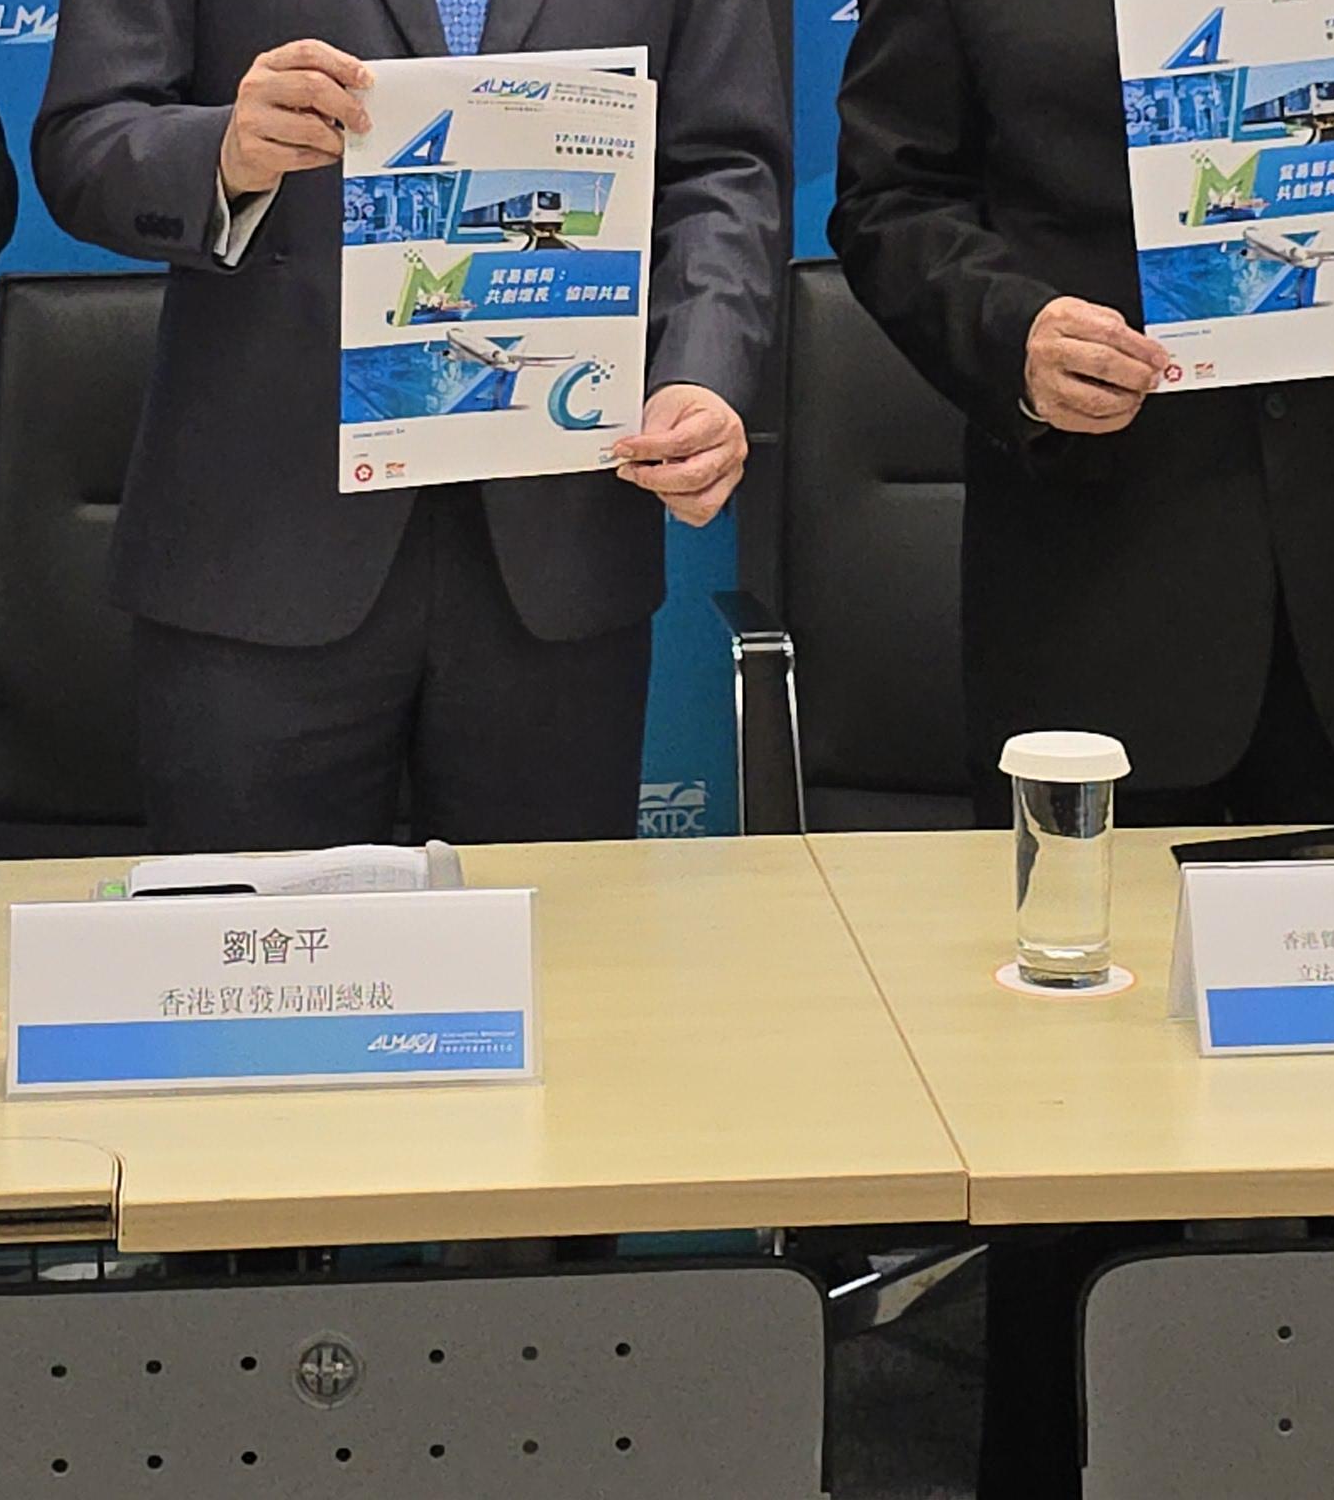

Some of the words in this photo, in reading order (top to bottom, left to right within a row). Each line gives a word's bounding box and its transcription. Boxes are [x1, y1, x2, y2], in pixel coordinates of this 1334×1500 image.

[221, 926, 329, 966] 劉會平
[158, 982, 395, 1017] 香港貿發局副總裁
